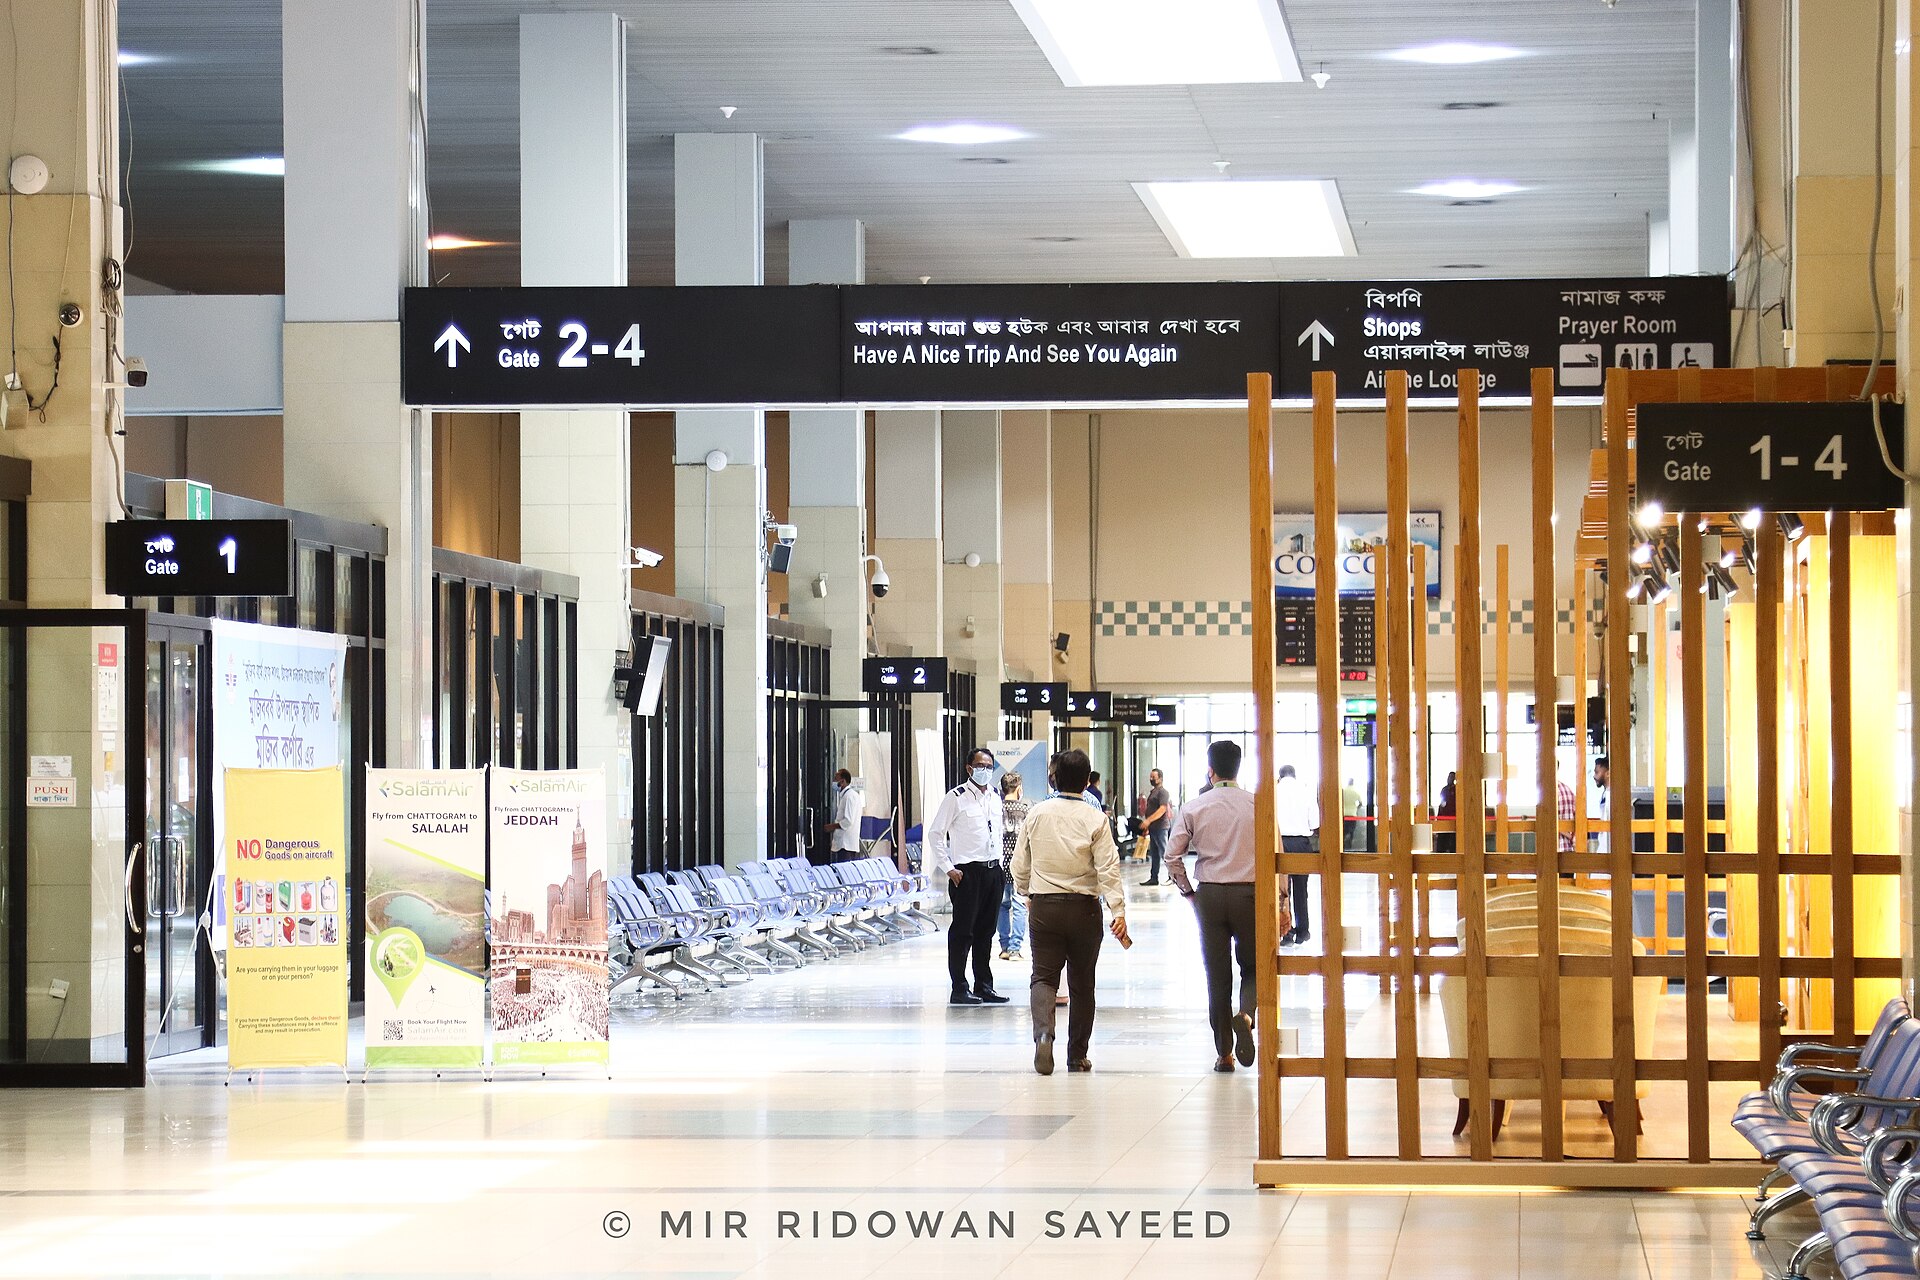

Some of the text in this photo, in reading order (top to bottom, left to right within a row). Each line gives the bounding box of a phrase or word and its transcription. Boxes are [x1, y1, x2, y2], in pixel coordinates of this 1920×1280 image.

[1364, 288, 1423, 309] বিপণি
[1560, 289, 1666, 306] নামাজ কক্ষ
[499, 318, 542, 340] গেট
[854, 317, 1241, 337] আপনার যাত্রা শুভ হউক এবং আবার দেখা হবে
[1363, 317, 1422, 341] Shops
[1559, 315, 1677, 339] Prayer Room
[558, 323, 646, 368] 2-4
[1473, 338, 1530, 359] লাউঞ্জ
[498, 348, 540, 368] Gate
[853, 343, 1177, 368] Have A Nice Trip And See You Again
[1429, 370, 1497, 393] Louge
[1663, 431, 1704, 450] গেট
[1664, 460, 1712, 481] Gate
[219, 539, 236, 574] 1
[145, 559, 179, 575] Gate
[913, 667, 926, 684] 2
[1040, 689, 1050, 703] 3
[1085, 698, 1096, 711] 4
[34, 786, 69, 794] PUSH
[392, 781, 473, 797] SalamAir
[520, 780, 587, 792] SalamAir
[372, 812, 384, 821] Fly
[385, 812, 404, 820] from
[406, 812, 466, 820] CHATTOGRAM
[504, 815, 558, 825] JEDDAH
[412, 823, 468, 833] SALALAH
[236, 839, 262, 859] NO
[265, 839, 319, 850] Dangerous
[264, 850, 290, 860] Goods
[305, 850, 334, 859] aircraft
[291, 973, 313, 981] person?
